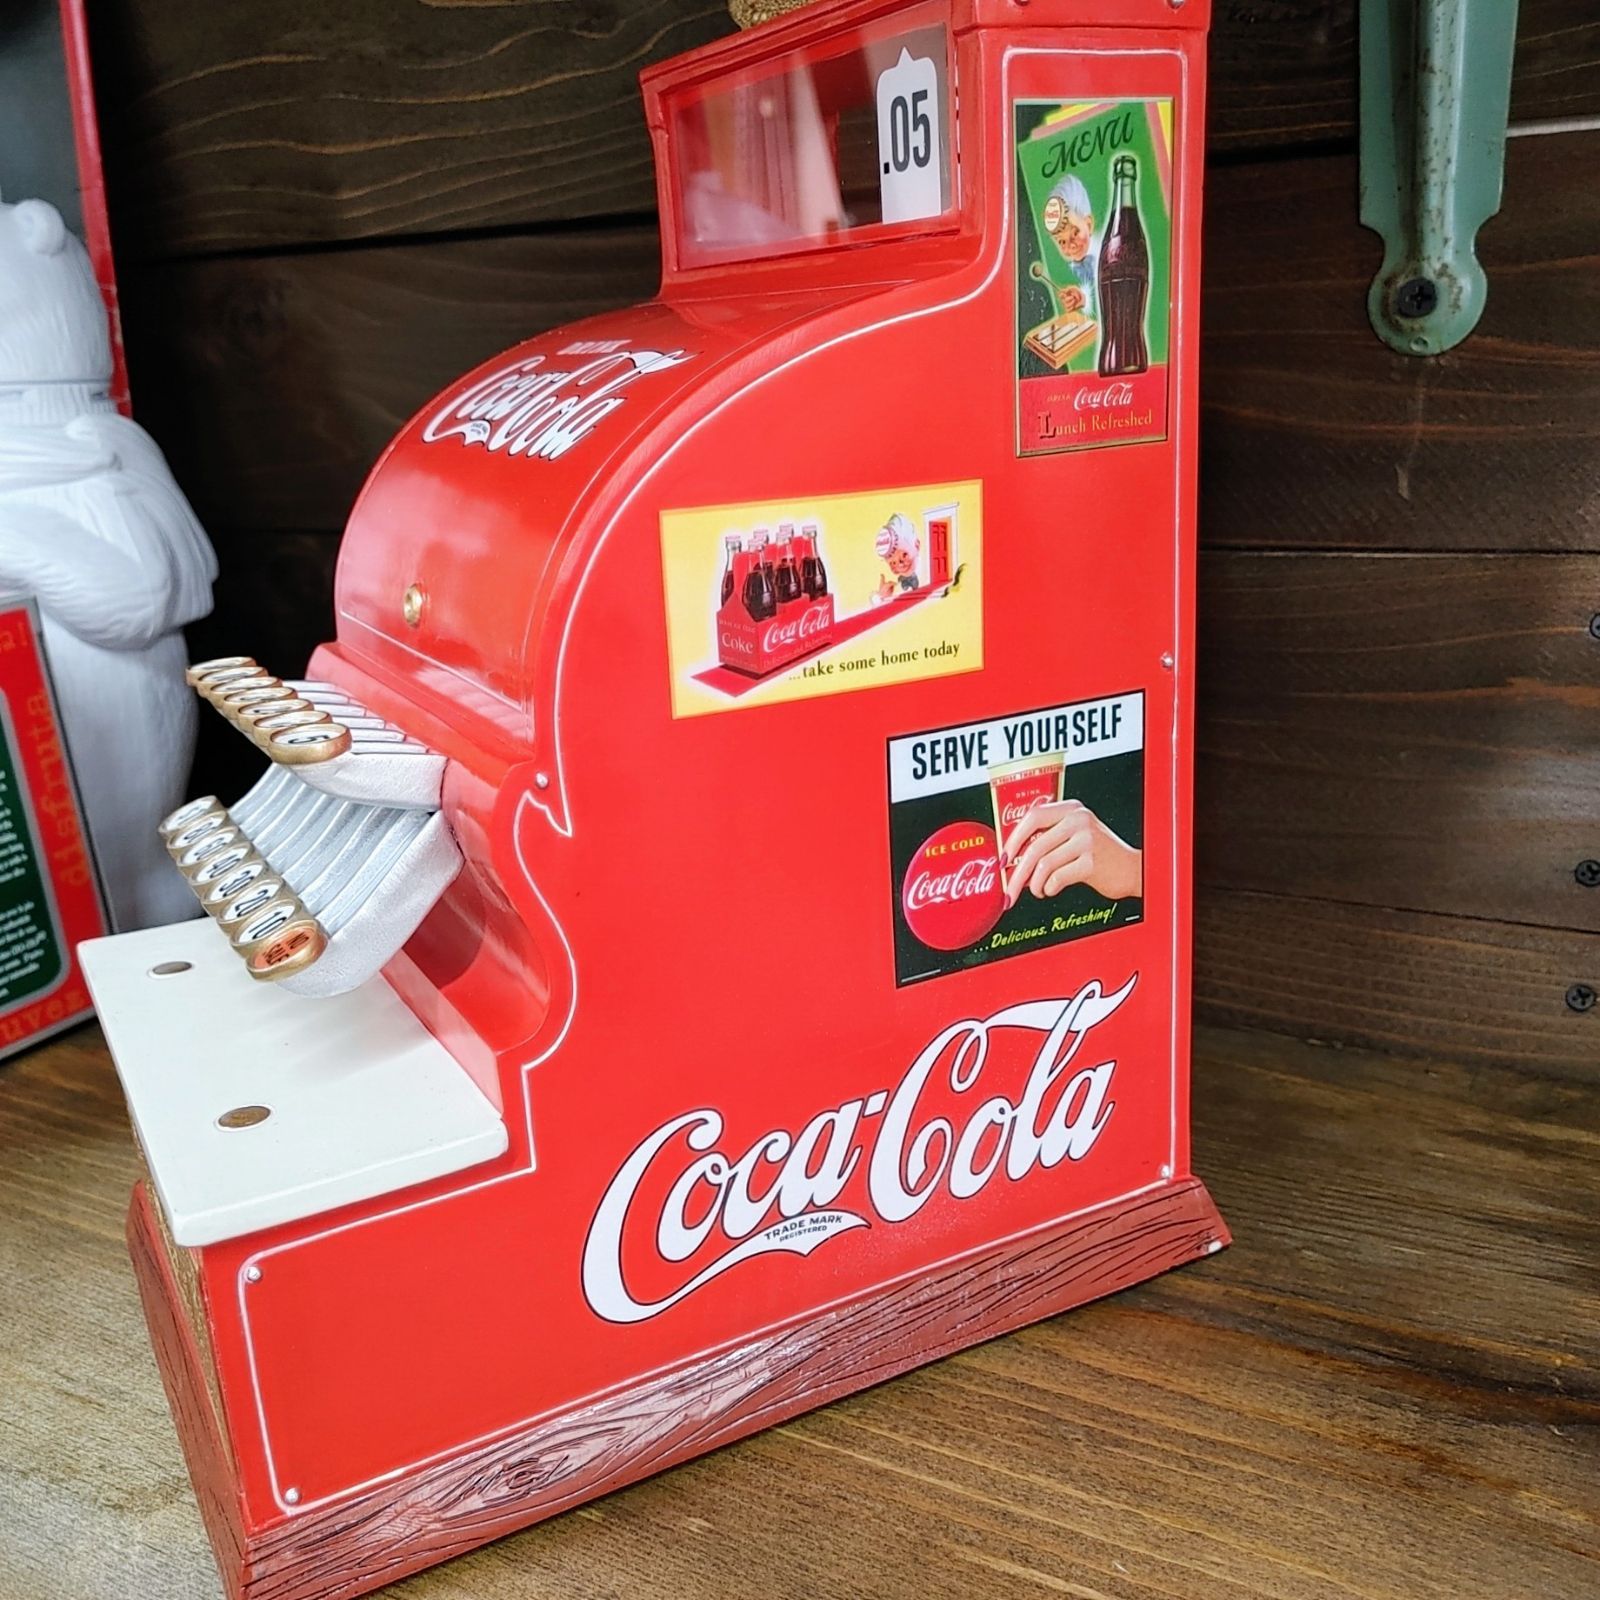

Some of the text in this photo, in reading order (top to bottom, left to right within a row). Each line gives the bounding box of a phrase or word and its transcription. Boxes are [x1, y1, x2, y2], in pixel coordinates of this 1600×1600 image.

[883, 89, 931, 174] .05
[1042, 112, 1134, 178] MENU
[1073, 383, 1134, 411] Coca-Cola
[1038, 409, 1153, 439] Lunch Refreshed
[763, 602, 830, 653] Coca-Cola
[721, 632, 753, 654] Coke
[839, 657, 876, 672] some
[881, 650, 919, 666] home
[924, 640, 960, 659] today
[911, 703, 1122, 781] SERVE YOURSELF
[925, 836, 985, 858] ICE COLD
[218, 869, 257, 898] 30
[907, 856, 998, 911] Coca-Cola
[234, 888, 272, 918] 20
[1051, 902, 1119, 932] Refreshing!
[248, 910, 289, 940] 10
[580, 970, 1140, 1325] Coca-Cola
[764, 1214, 844, 1241] TRADE MARK
[779, 1224, 828, 1243] REGISTERED
